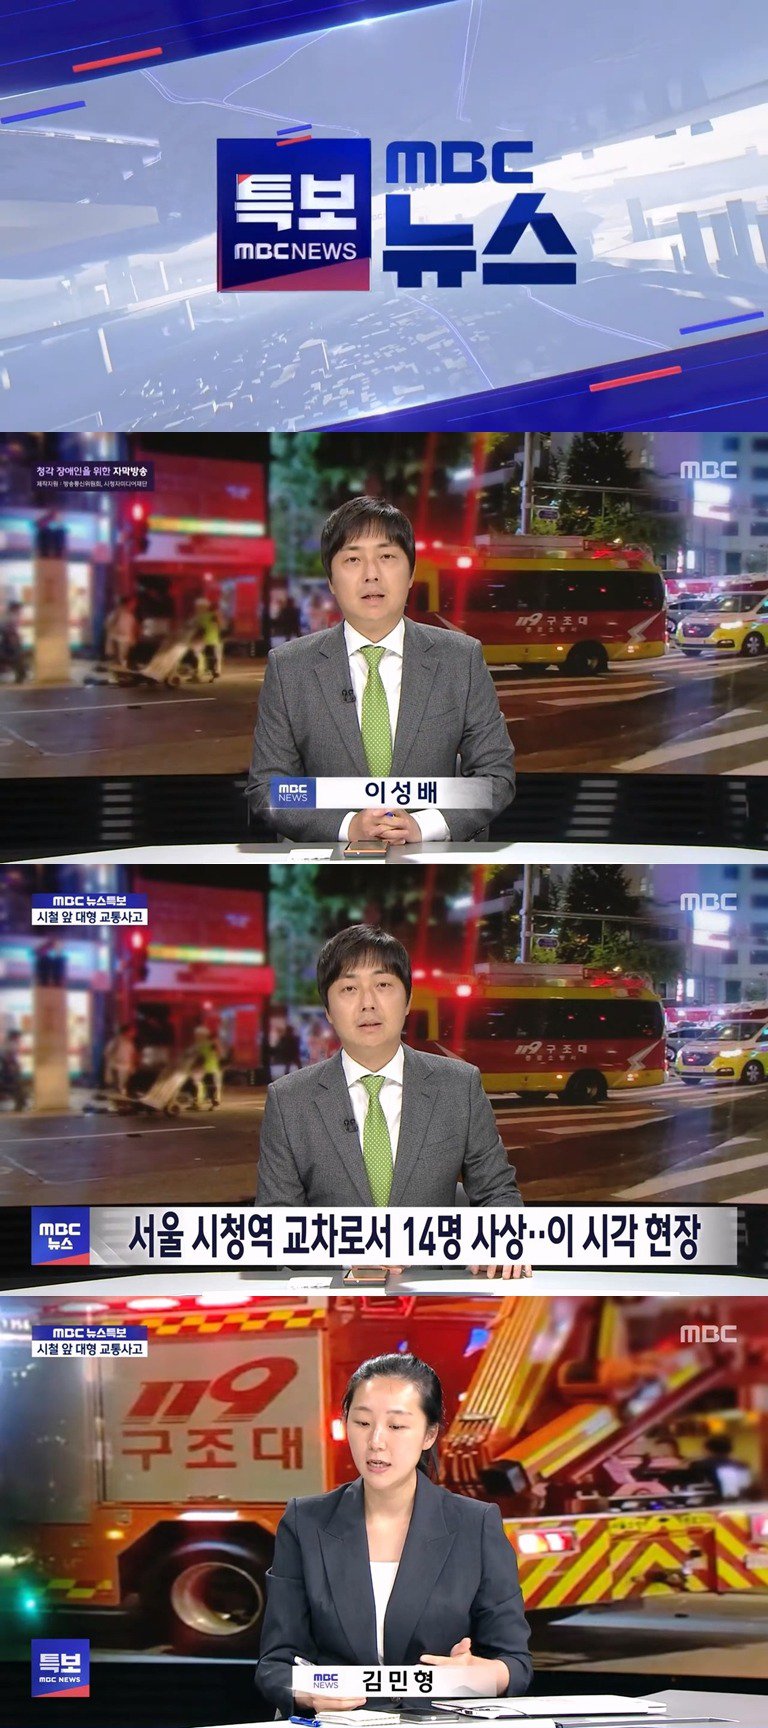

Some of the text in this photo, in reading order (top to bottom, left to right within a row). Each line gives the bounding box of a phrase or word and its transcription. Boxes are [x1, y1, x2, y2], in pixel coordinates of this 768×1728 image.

[515, 612, 543, 627] 119
[514, 1041, 542, 1055] 119
[121, 1357, 299, 1424] 119
[121, 1427, 303, 1471] 구조대
